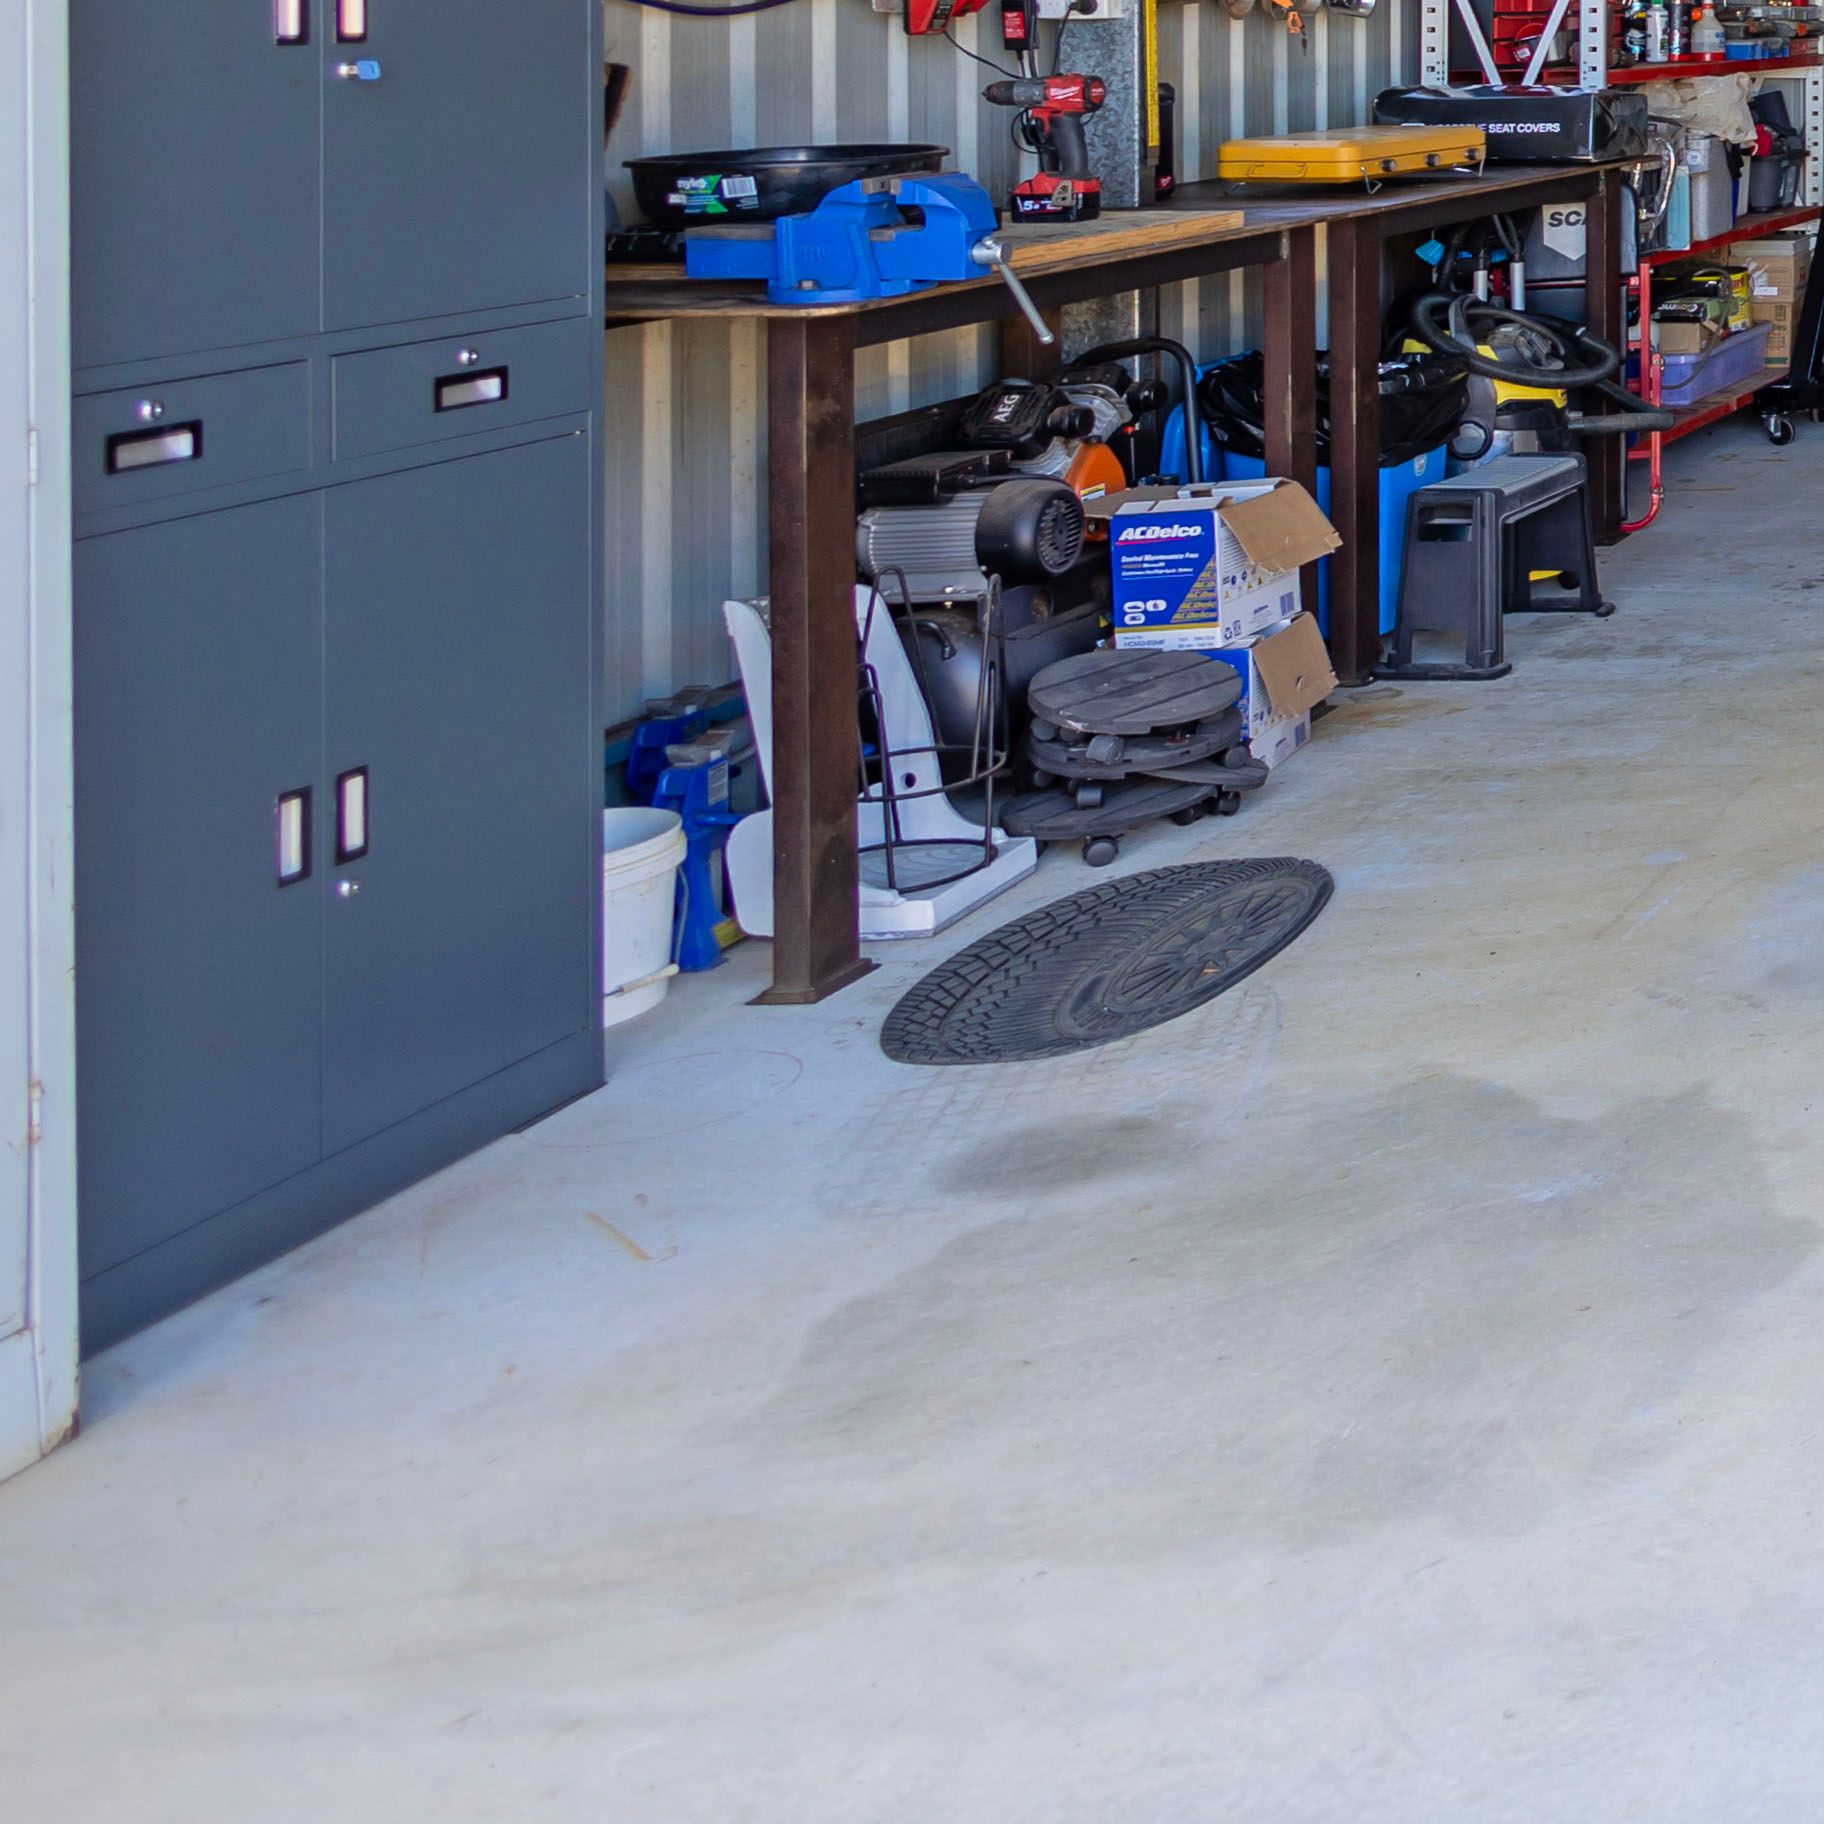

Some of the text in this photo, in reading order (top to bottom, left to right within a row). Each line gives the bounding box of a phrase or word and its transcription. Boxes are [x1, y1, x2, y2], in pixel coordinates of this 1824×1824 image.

[1488, 122, 1515, 134] SEAT
[1516, 122, 1561, 134] COVERS
[1548, 210, 1586, 228] SC
[993, 394, 1021, 423] AEG
[1118, 524, 1203, 542] ACDelco
